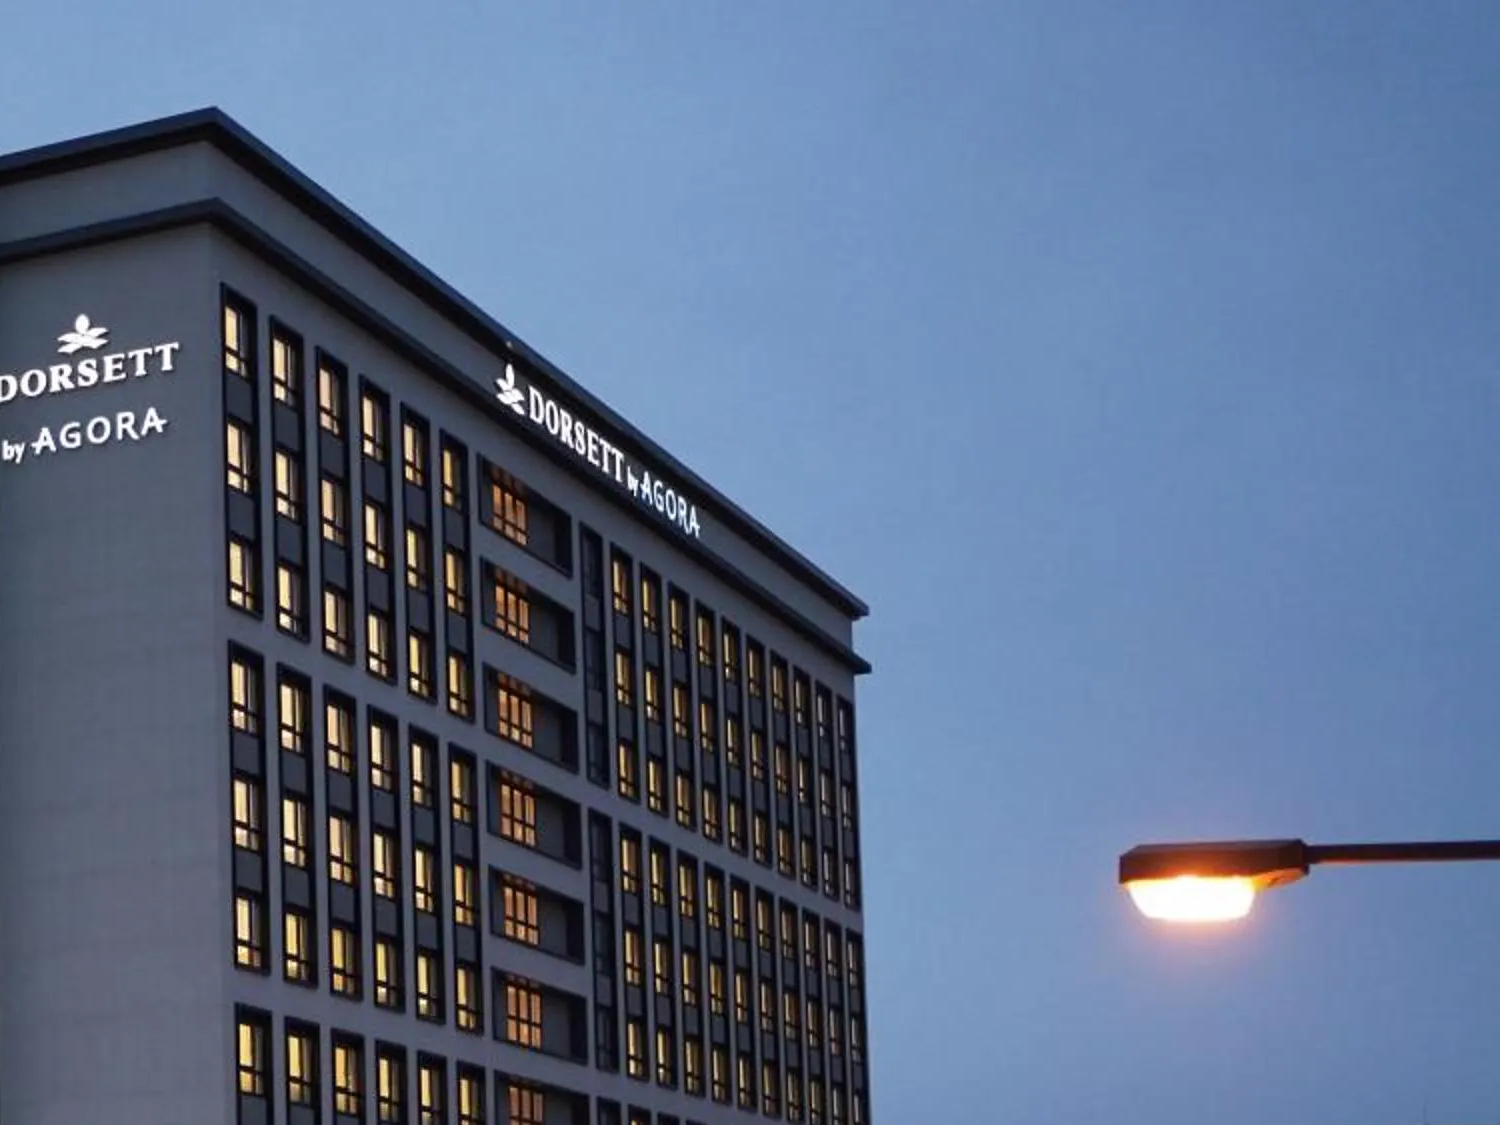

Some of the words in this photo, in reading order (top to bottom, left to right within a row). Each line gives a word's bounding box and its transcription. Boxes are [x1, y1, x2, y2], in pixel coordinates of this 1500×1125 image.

[2, 439, 25, 463] by
[31, 406, 168, 455] AGORA
[528, 384, 624, 483] DORSETT
[640, 470, 701, 538] AGORA
